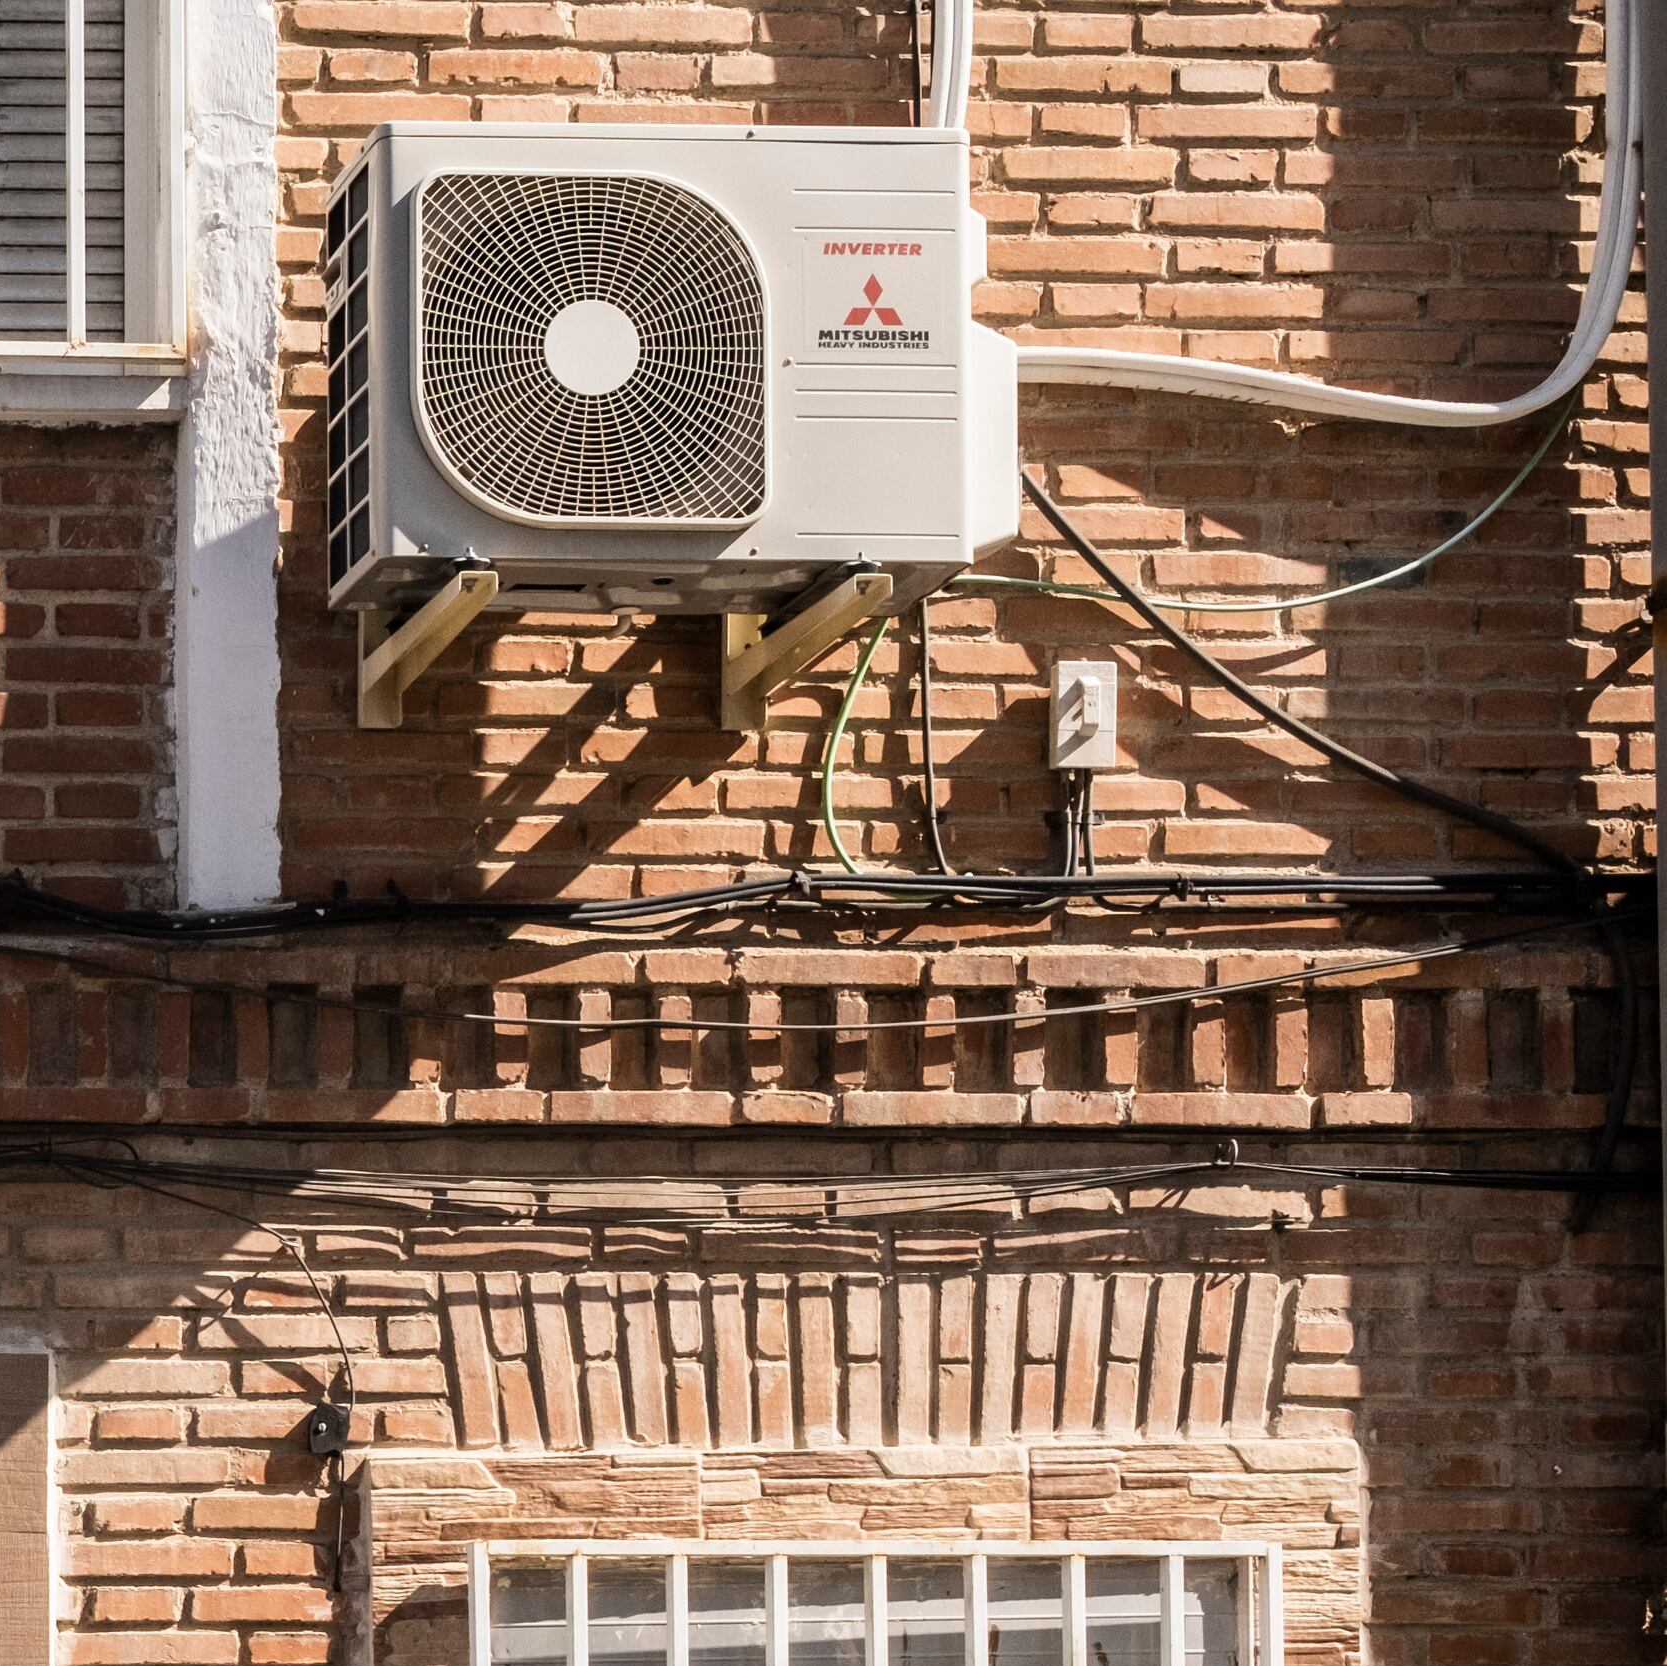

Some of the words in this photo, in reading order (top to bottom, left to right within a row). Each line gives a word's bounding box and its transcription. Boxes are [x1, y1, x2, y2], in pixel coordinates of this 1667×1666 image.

[823, 242, 923, 256] INVERTER
[818, 330, 930, 342] MITSUBISHI
[818, 341, 855, 349] HEAVY
[858, 341, 930, 350] INDUSTRIES
